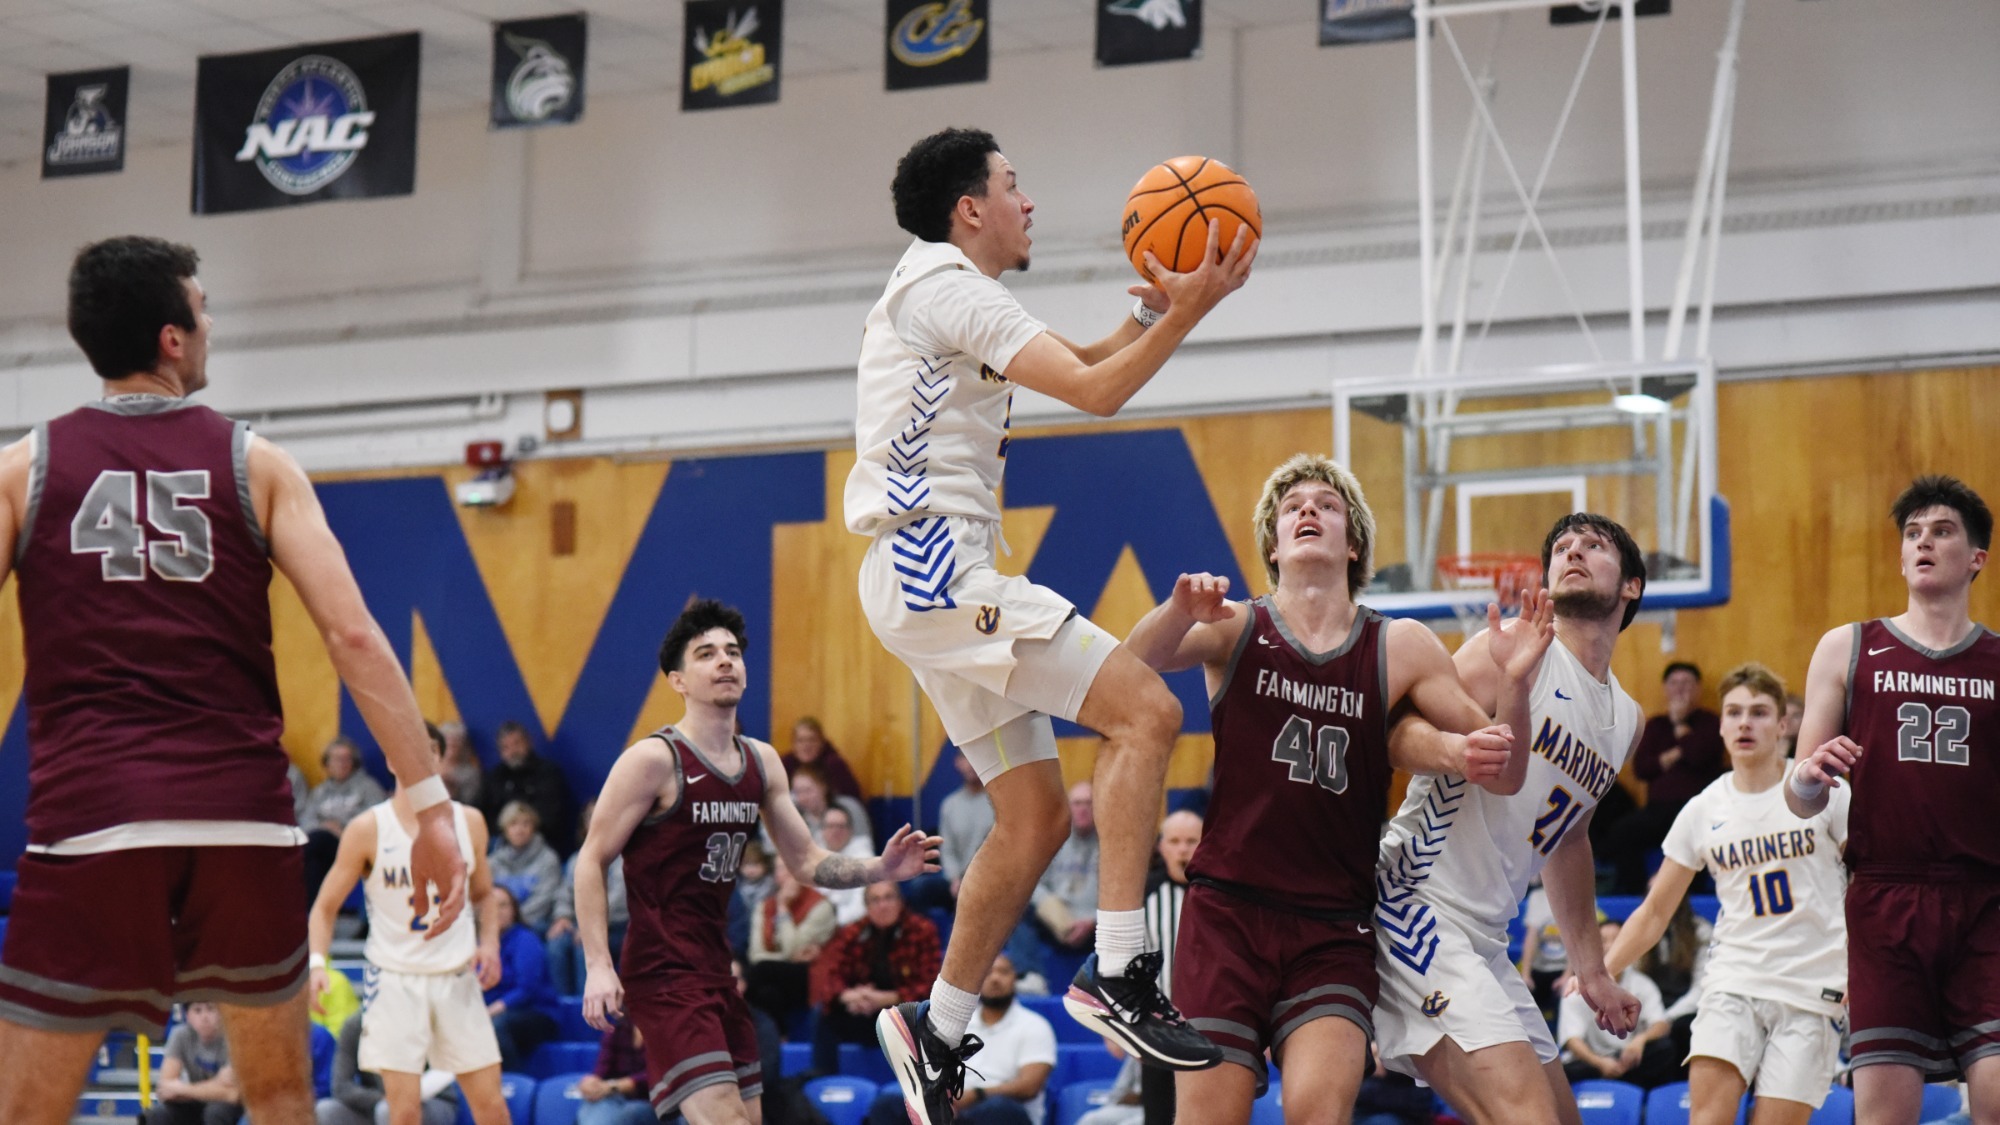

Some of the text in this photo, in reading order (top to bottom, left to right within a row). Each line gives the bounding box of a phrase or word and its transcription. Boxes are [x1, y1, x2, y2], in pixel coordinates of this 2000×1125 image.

[235, 111, 376, 161] NAC
[71, 470, 214, 582] 45
[1256, 668, 1364, 719] FARMINGTON
[1874, 670, 1995, 700] FARMINGTON
[1271, 713, 1350, 795] 40
[1531, 715, 1618, 801] MARINER
[1897, 702, 1970, 766] 22
[692, 801, 760, 824] FARMINGTO
[1527, 784, 1584, 857] 21
[698, 832, 747, 883] 30
[1711, 827, 1815, 871] MARINERS
[1748, 867, 1794, 917] 10
